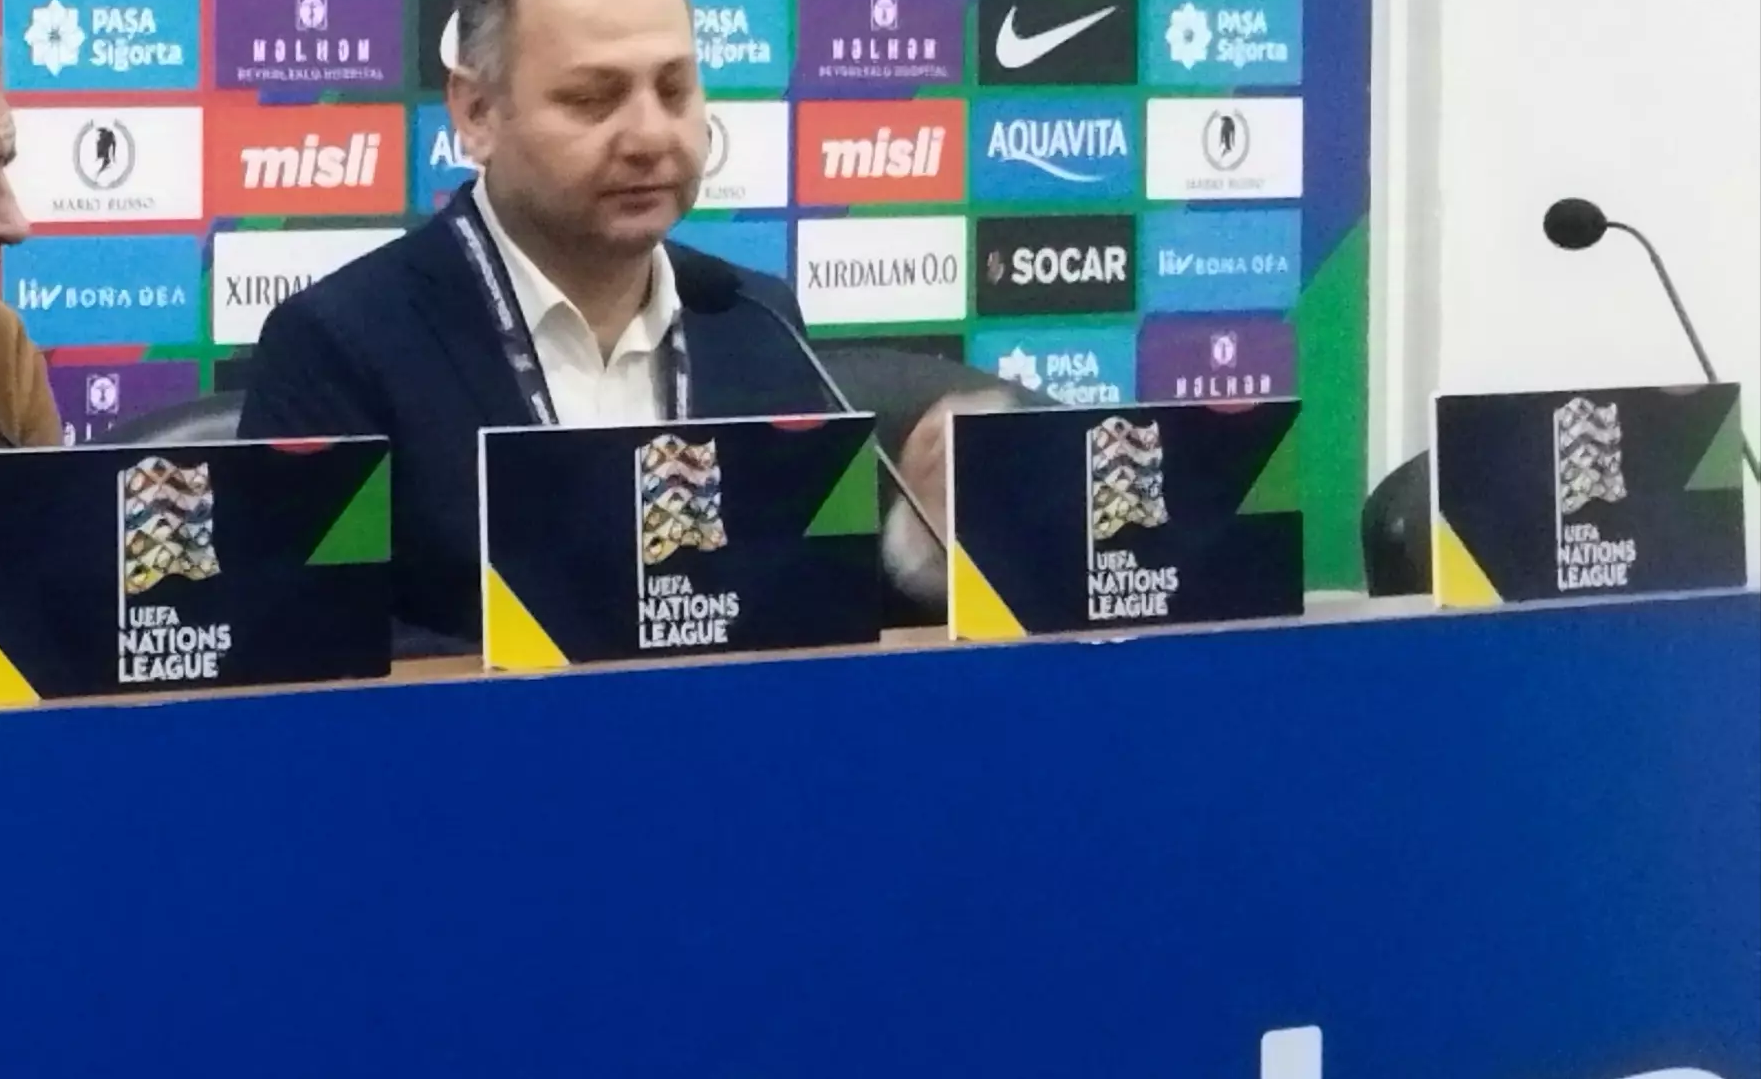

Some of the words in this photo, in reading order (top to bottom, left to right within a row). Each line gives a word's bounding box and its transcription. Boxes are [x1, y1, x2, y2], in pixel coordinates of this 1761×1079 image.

[92, 8, 157, 38] PAŞA
[821, 127, 944, 179] misli
[988, 118, 1127, 158] AQUAVITA
[241, 133, 381, 189] misli
[52, 198, 101, 212] MARIO
[109, 197, 155, 211] RUSSO
[807, 258, 915, 288] XIRDALAN
[921, 252, 957, 285] 0.0
[1011, 245, 1126, 285] SOCAR
[66, 287, 132, 310] BONA
[140, 285, 186, 307] DEA
[226, 275, 312, 306] XIRDA
[1097, 550, 1138, 571] UEFA
[1558, 539, 1637, 566] NATIONS
[648, 575, 693, 597] UEFA
[1088, 567, 1179, 596] NATIONS
[1557, 562, 1629, 590] LEAGUE
[129, 606, 180, 629] UEFA
[639, 592, 740, 622] NATIONS
[1088, 592, 1169, 620] LEAGUE
[118, 624, 232, 656] NATIONS
[639, 619, 728, 649] LEAGUE
[118, 651, 219, 683] LEAGUE
